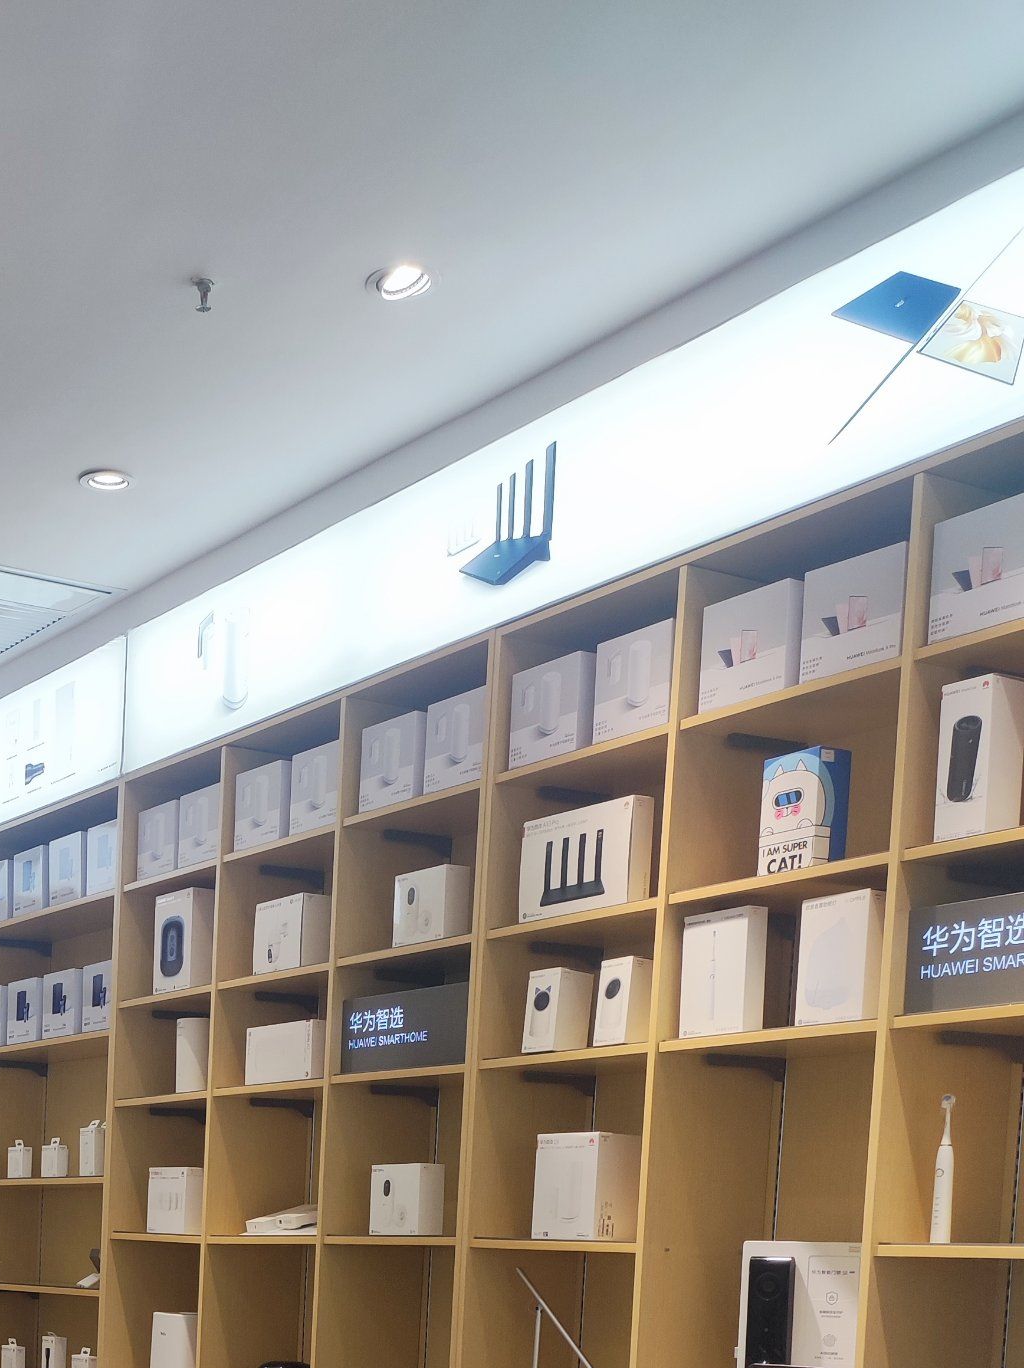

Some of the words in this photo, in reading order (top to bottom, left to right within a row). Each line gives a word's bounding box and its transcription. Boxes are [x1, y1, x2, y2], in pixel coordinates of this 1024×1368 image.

[766, 846, 781, 857] AM
[782, 841, 808, 854] SUPER
[766, 853, 803, 874] CAT!
[921, 912, 1024, 957] 华为智选
[920, 958, 979, 980] HUAWEI
[349, 1005, 404, 1034] 华为智选
[348, 1036, 376, 1050] HUAWEI
[378, 1030, 428, 1046] SMARTHOME
